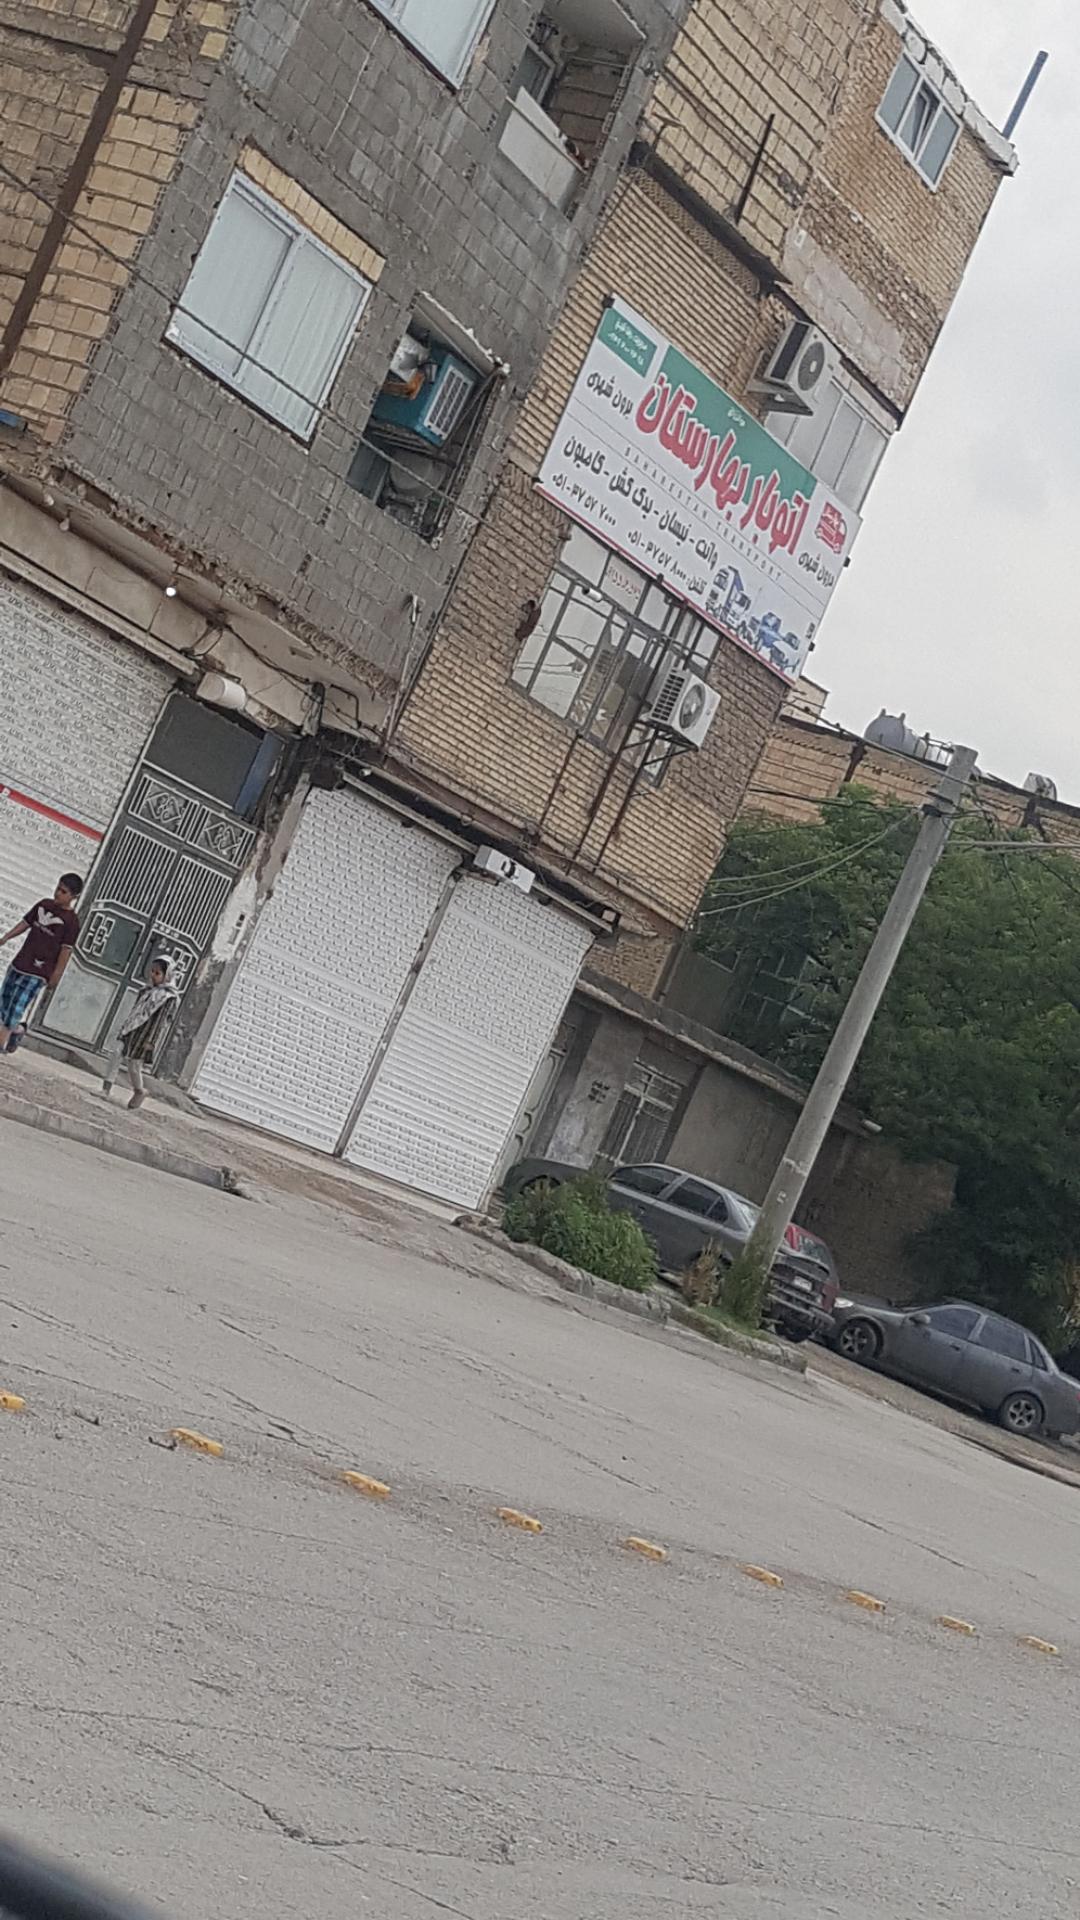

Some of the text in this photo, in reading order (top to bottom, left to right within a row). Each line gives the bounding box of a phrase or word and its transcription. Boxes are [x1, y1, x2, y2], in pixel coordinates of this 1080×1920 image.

[637, 374, 810, 555] اتوبار بهارستان
[716, 522, 782, 579] TRANSPORT
